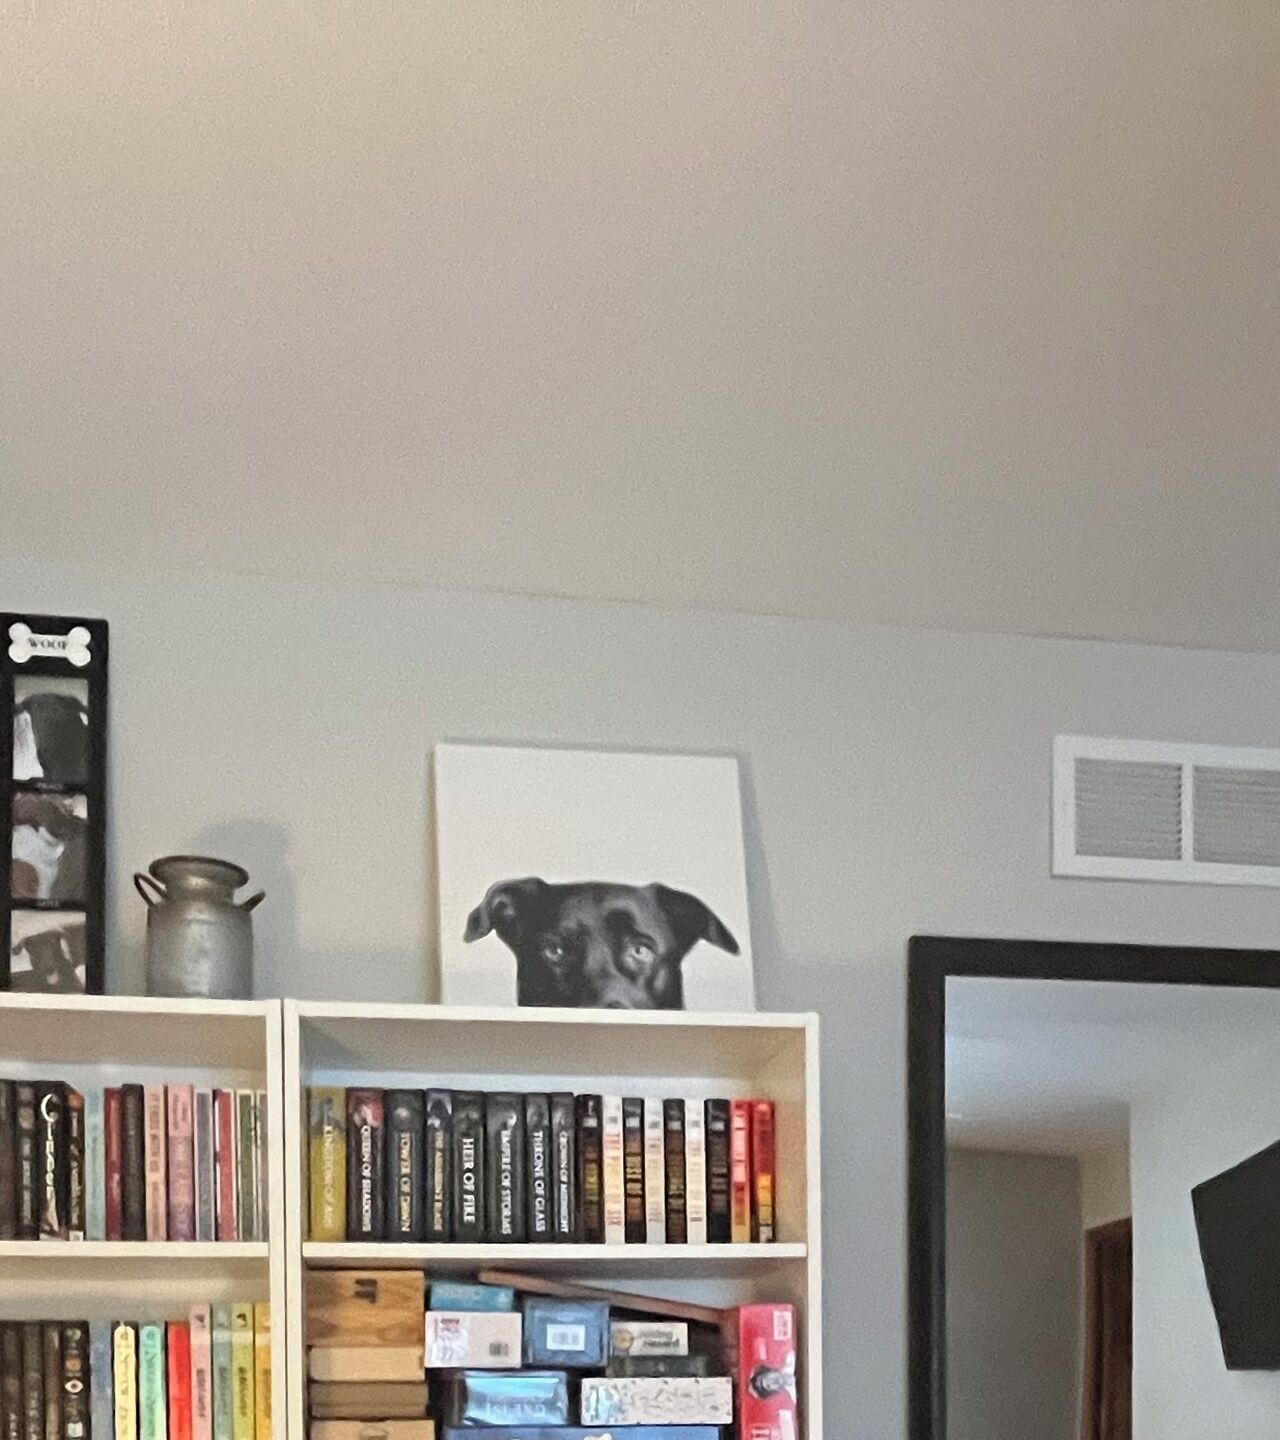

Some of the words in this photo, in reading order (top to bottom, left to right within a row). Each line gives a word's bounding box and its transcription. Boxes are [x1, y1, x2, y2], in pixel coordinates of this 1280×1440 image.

[361, 1125, 371, 1161] QUEEN
[400, 1132, 411, 1174] TOWER
[463, 1138, 475, 1170] HEIR
[500, 1130, 511, 1170] EMPIRE
[533, 1131, 544, 1177] THRONE
[400, 1177, 411, 1193] OF
[463, 1172, 475, 1191] OF
[500, 1172, 511, 1188] OF
[534, 1179, 545, 1195] OF
[362, 1179, 372, 1232] SHADOWS
[401, 1196, 411, 1232] DAWN
[463, 1194, 475, 1224] FIRE
[500, 1190, 512, 1235] STORMS
[534, 1197, 545, 1232] GLASS
